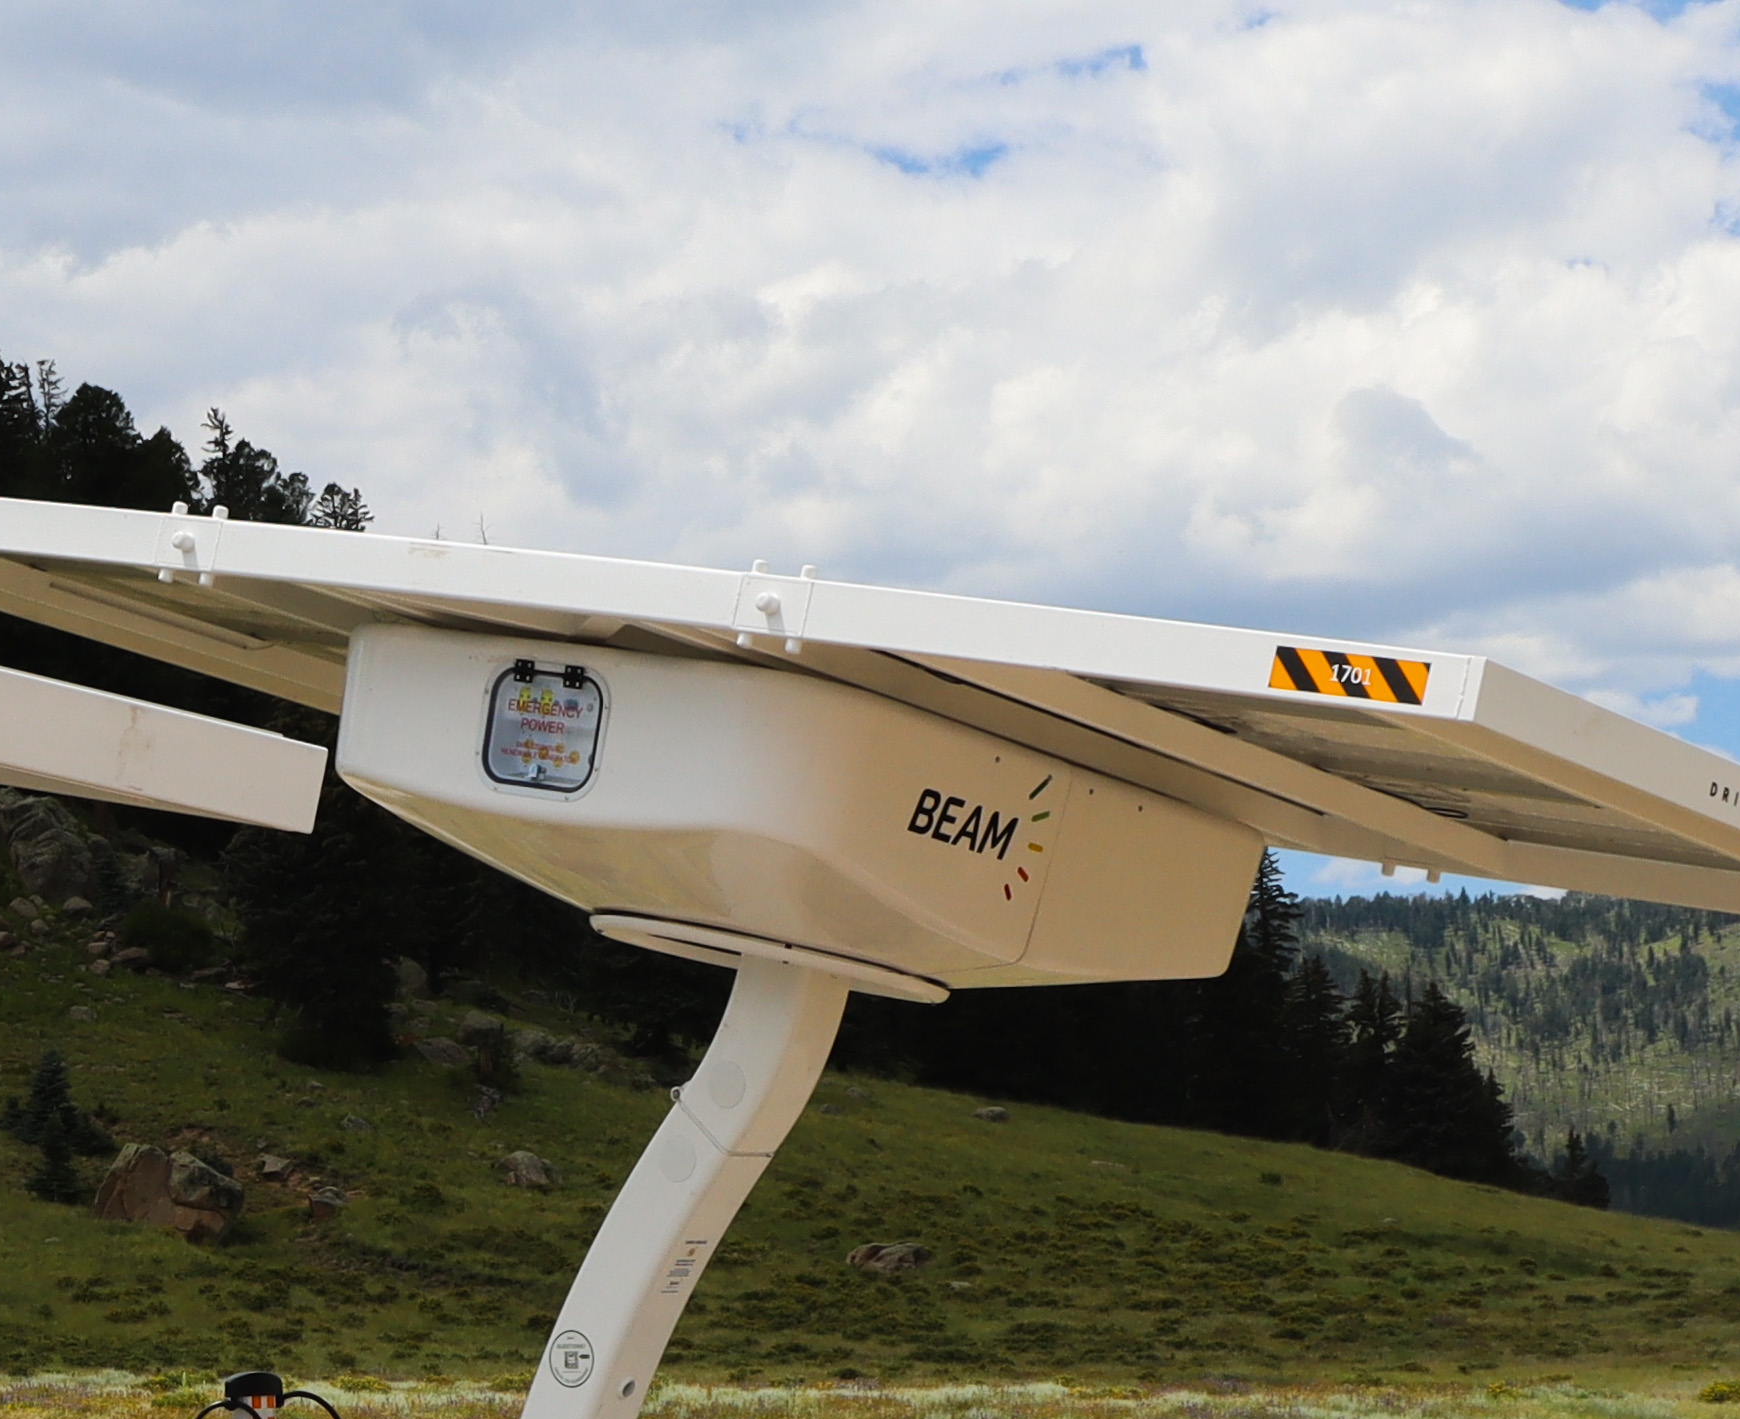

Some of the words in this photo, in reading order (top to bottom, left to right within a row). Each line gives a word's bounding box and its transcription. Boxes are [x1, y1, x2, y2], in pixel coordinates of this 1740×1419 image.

[1330, 664, 1371, 686] 1701
[508, 698, 583, 719] EMERGENCY
[521, 718, 565, 735] POWER
[907, 788, 1019, 860] BEAM
